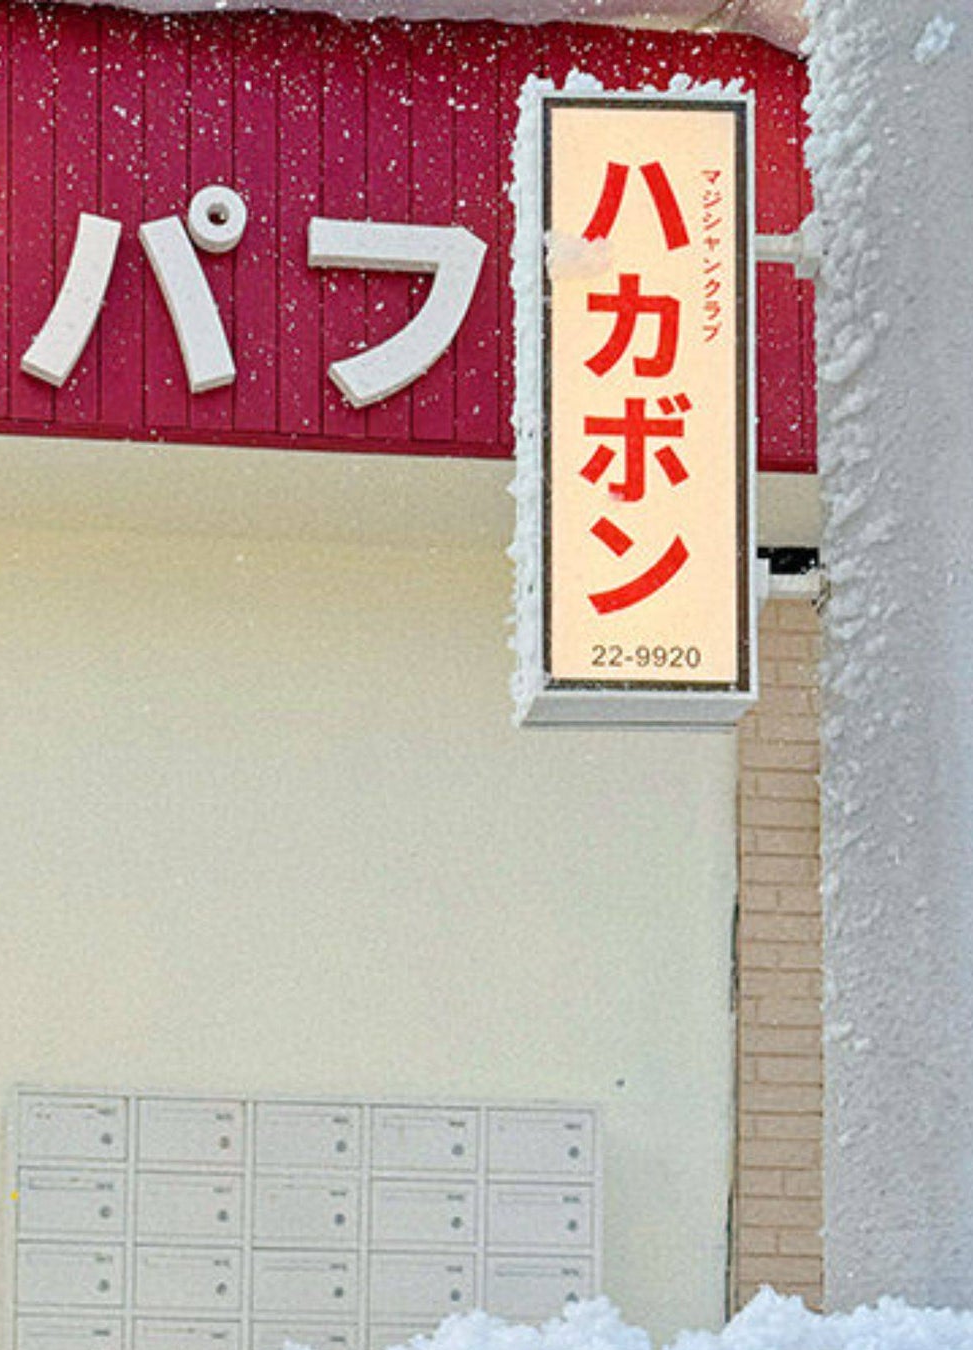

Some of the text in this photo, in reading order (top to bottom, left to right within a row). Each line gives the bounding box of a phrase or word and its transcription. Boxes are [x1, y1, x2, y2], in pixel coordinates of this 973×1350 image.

[579, 160, 692, 616] ハカボン
[591, 644, 702, 668] 22-9920
